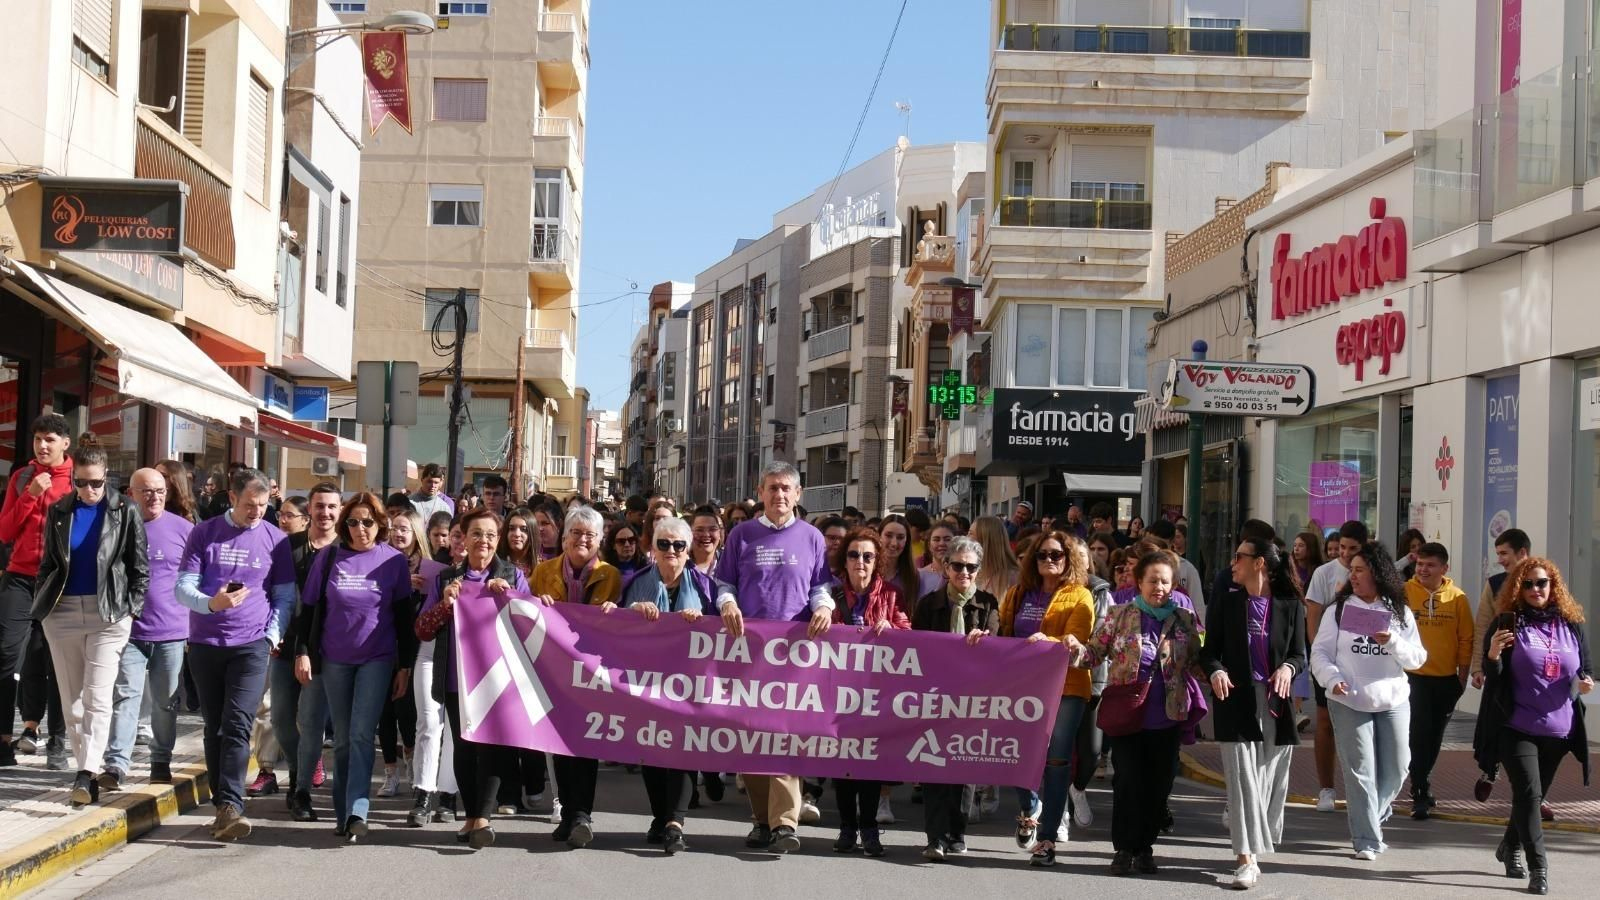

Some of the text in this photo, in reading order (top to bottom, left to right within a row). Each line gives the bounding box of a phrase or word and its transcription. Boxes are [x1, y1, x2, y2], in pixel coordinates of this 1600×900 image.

[84, 215, 149, 225] PELUQUERIAS
[97, 224, 175, 240] LOW COST
[1270, 197, 1407, 320] farmacia
[157, 262, 178, 290] COST
[1336, 298, 1406, 381] espejo
[1223, 366, 1297, 390] VOLANDO
[929, 386, 976, 404] 13:15
[1214, 401, 1233, 409] 950
[1236, 402, 1248, 410] 40
[1266, 403, 1278, 411] 51
[1489, 394, 1520, 423] PATY
[1010, 401, 1136, 441] farmacia g
[1008, 435, 1069, 447] DESDE 1914
[688, 627, 923, 677] DÍA CONTRA
[1351, 644, 1393, 656] adida
[571, 660, 1044, 723] LA VIOLENCIA DE GÉNERO
[584, 711, 879, 761] 25 de NOVIEMBRE
[946, 728, 1020, 759] adra
[950, 755, 1018, 764] AYUNTAMIENTO
